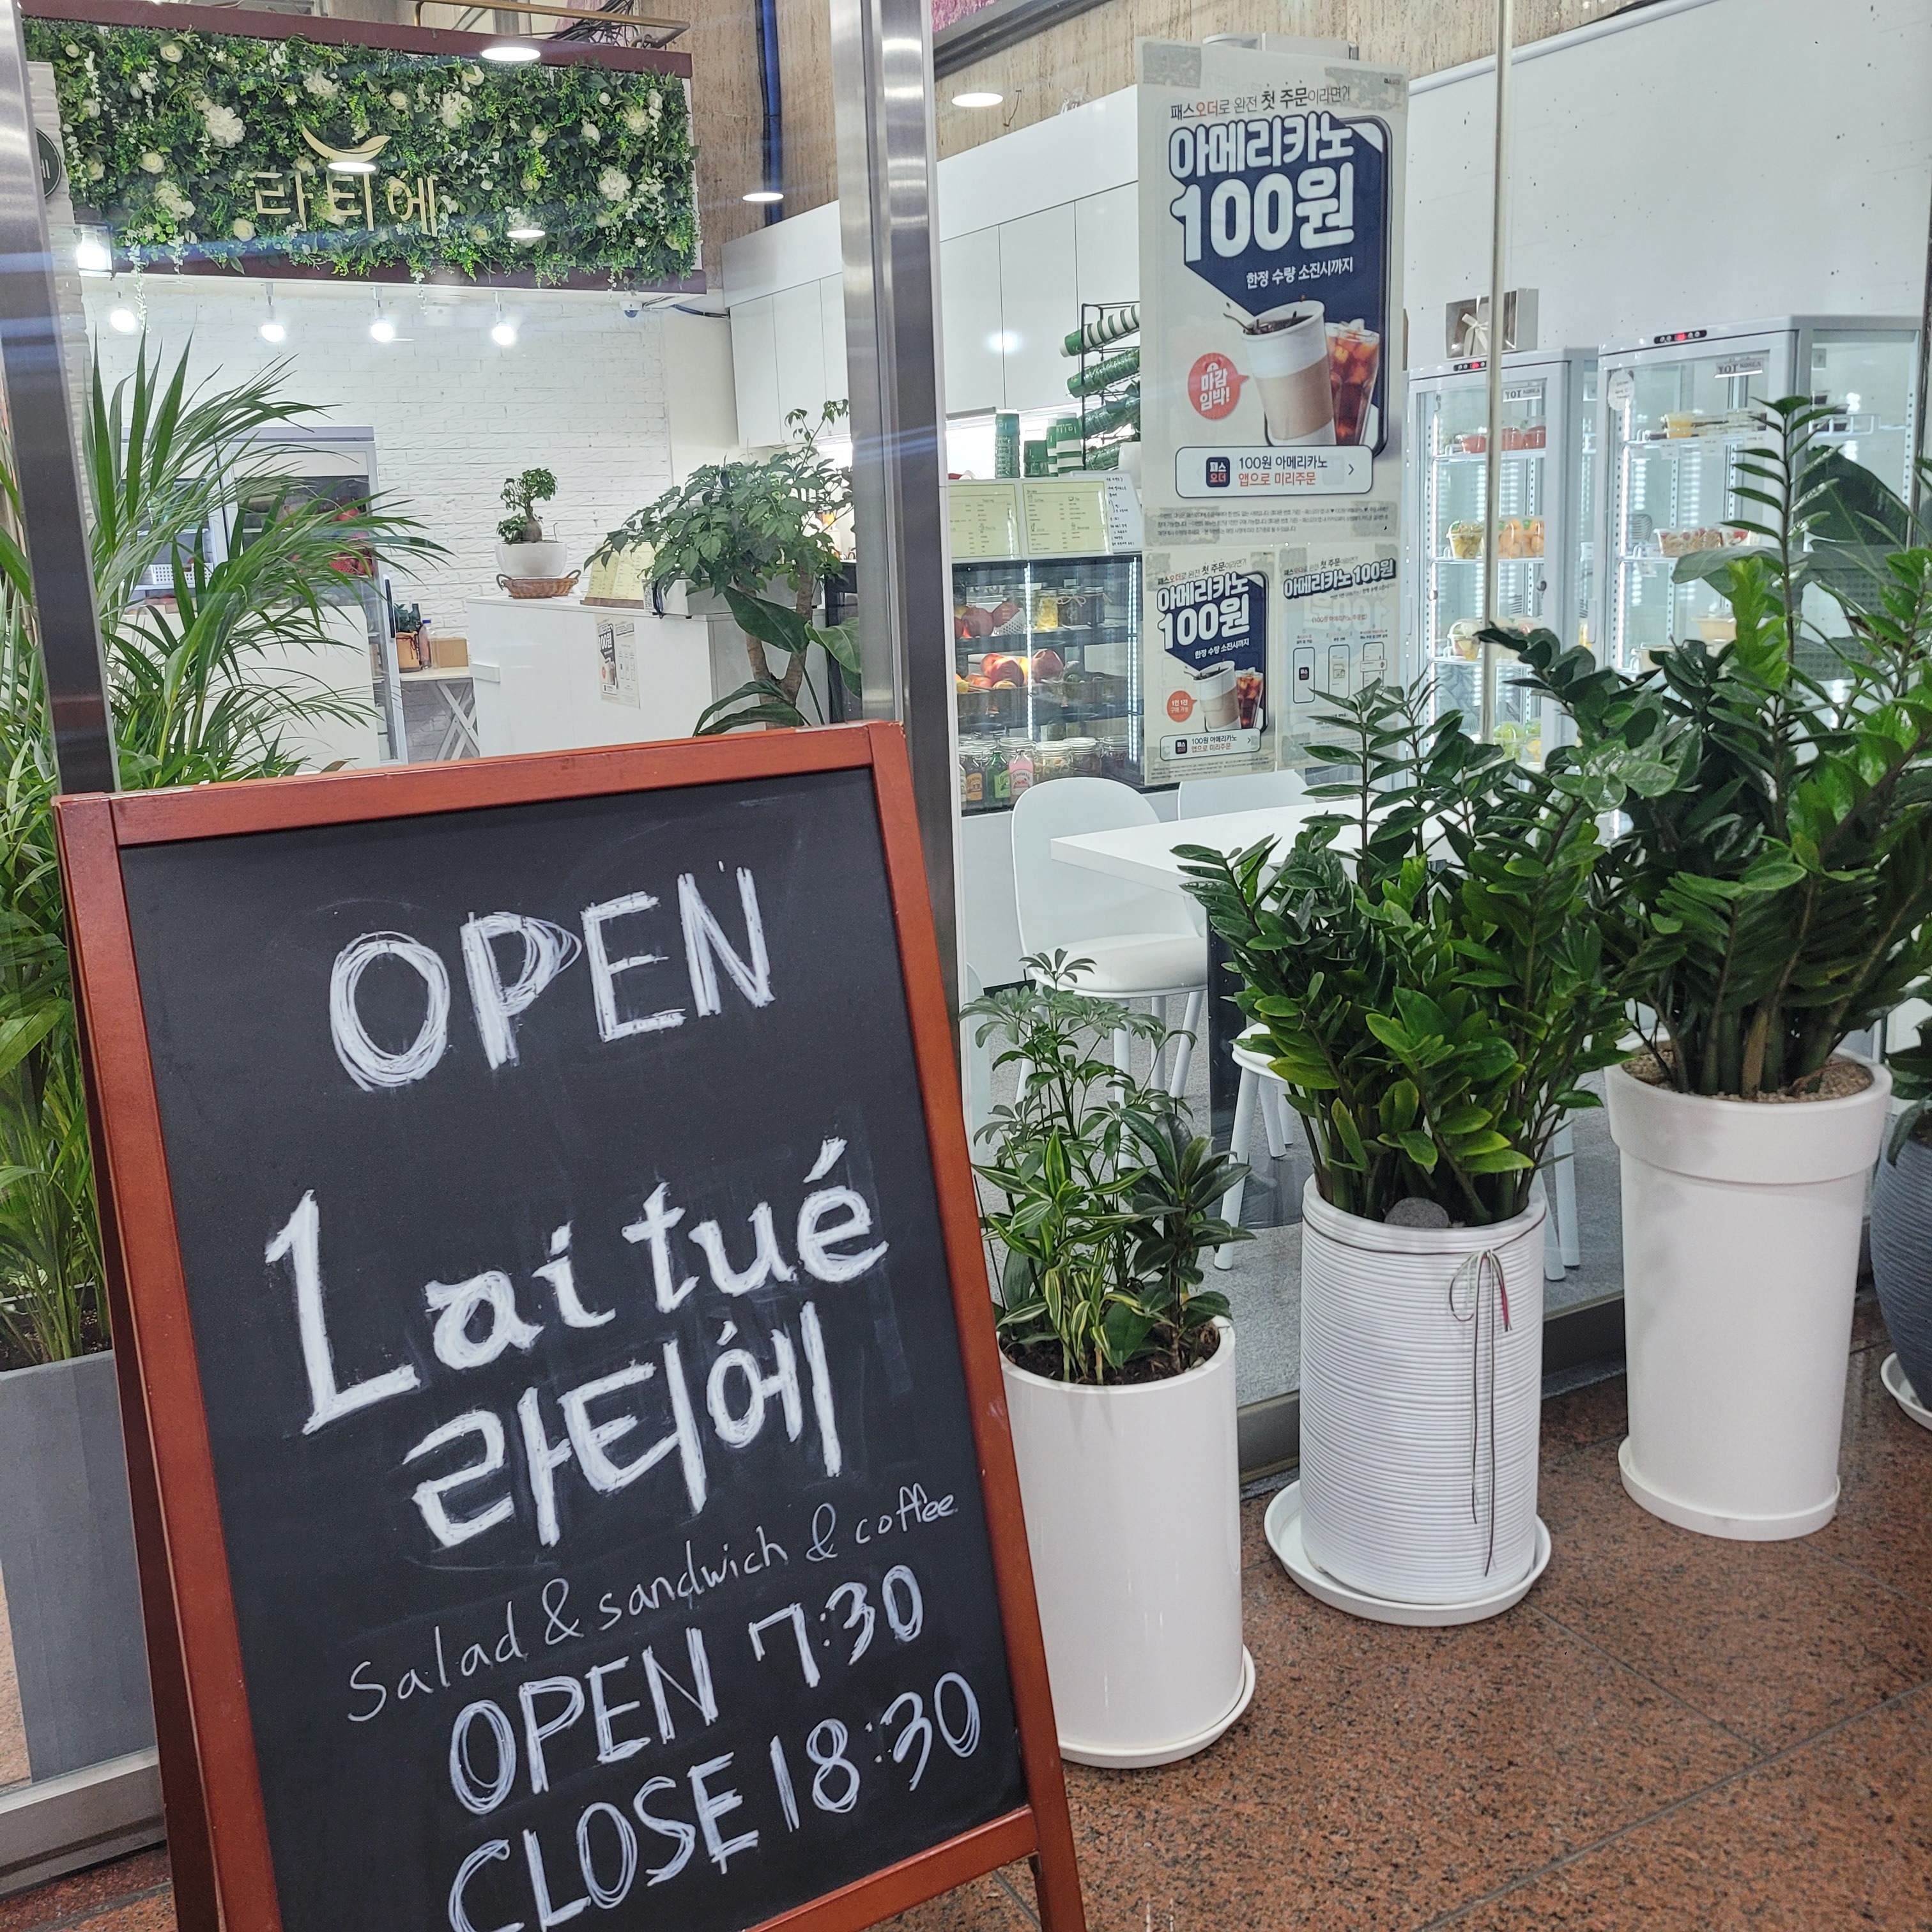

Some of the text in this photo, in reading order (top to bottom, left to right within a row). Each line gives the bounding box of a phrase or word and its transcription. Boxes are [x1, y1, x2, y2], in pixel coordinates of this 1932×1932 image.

[1170, 86, 1351, 121] 패스오더로 완전 첫 주문이라면?!
[1170, 111, 1354, 178] 아메리카노
[256, 171, 439, 237] 라티에
[1170, 162, 1354, 262] 100원
[1246, 256, 1354, 290] 한정 수량 소진시까지
[1200, 387, 1230, 411] 임박!
[1201, 368, 1228, 392] 마감
[1505, 390, 1522, 399] YOT
[1210, 473, 1227, 483] 오더
[1238, 472, 1316, 487] 앱으로 미리주문
[1239, 455, 1328, 470] 100원 아메리카노
[1202, 565, 1209, 575] 첫
[1284, 569, 1353, 599] 아메리카노
[1353, 558, 1397, 585] 100원
[1157, 571, 1250, 612] 아메리카노
[1158, 593, 1250, 650] 100원
[1192, 735, 1237, 744] 100원 아메리카노
[330, 866, 774, 1092] OPEN
[402, 1301, 841, 1548] 라티에
[542, 1577, 584, 1645] &
[598, 1524, 788, 1632] sandwich
[805, 1501, 838, 1561] &
[854, 1485, 958, 1545] coffee
[449, 1564, 924, 1815] OPEN 7:30
[448, 1671, 981, 1932] CLOSE 18:30
